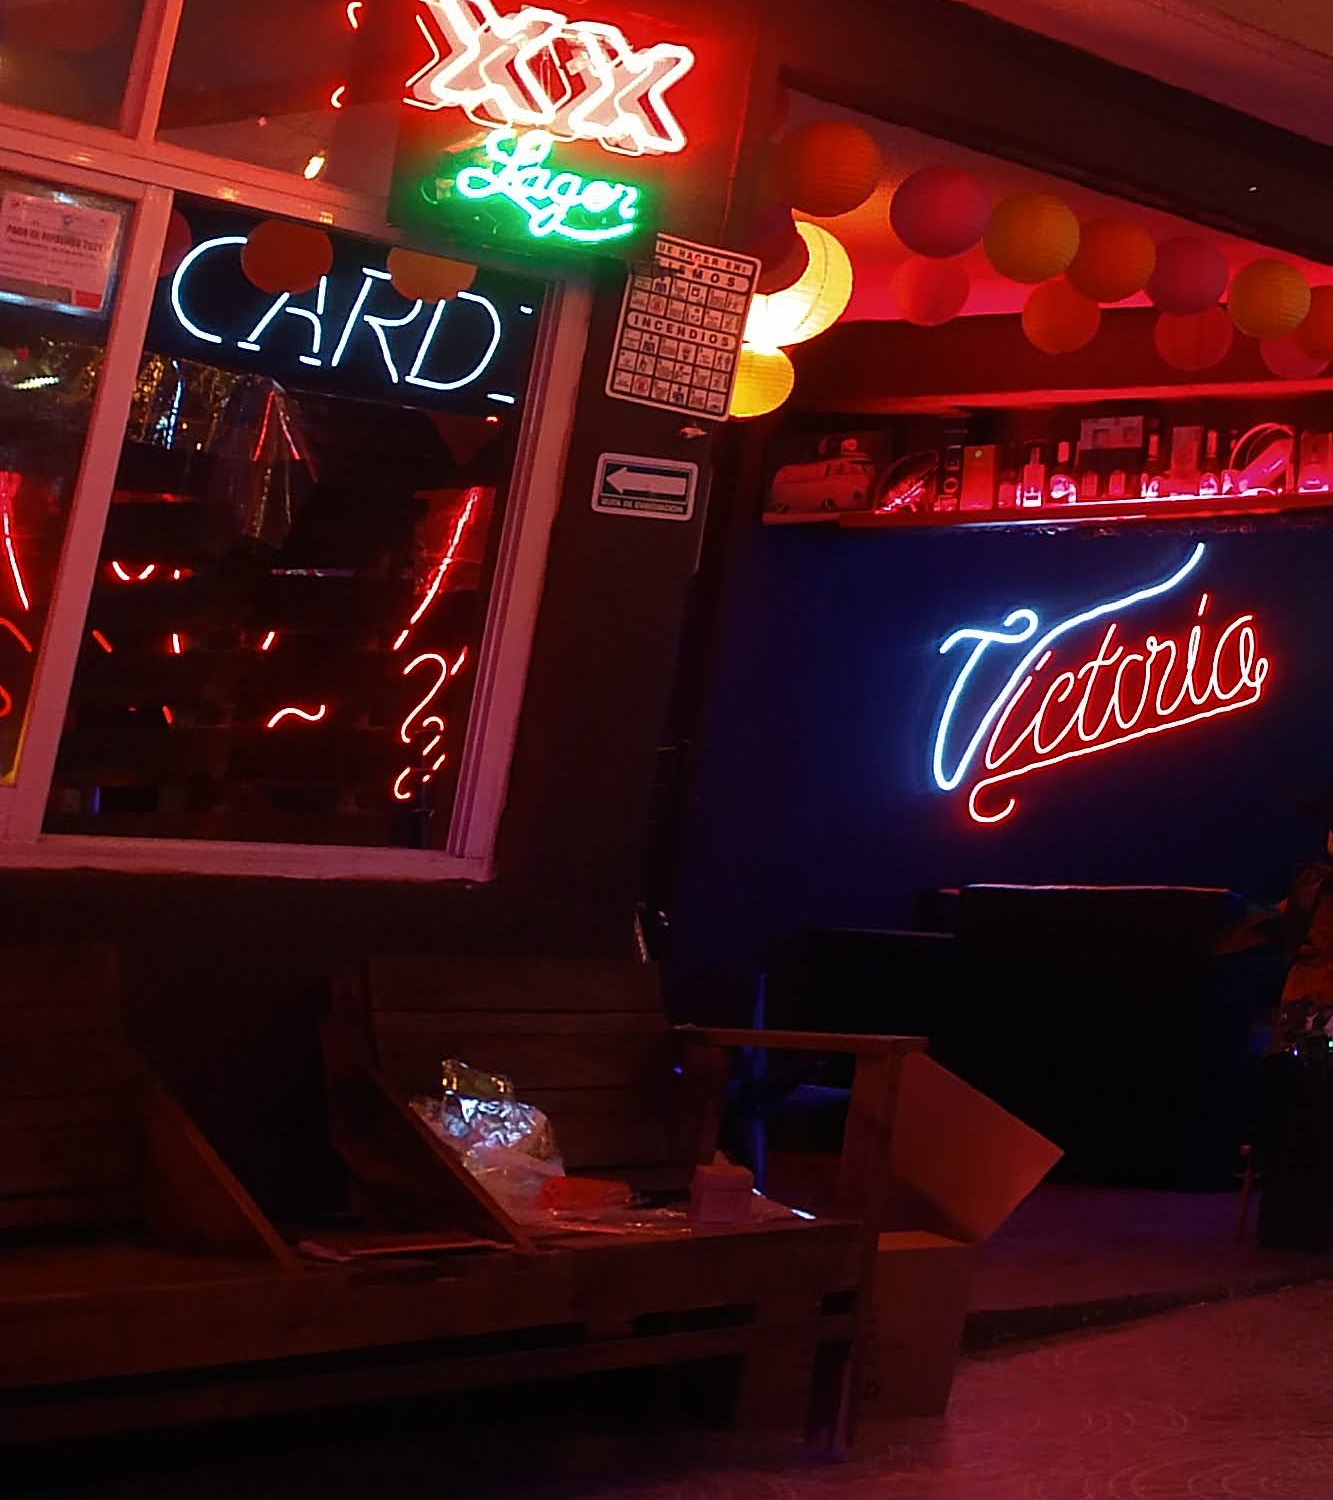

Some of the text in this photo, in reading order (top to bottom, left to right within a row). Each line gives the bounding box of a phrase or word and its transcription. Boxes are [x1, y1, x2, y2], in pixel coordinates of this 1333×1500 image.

[455, 129, 638, 242] Lager
[633, 313, 731, 347] INCENDIOS
[933, 542, 1269, 822] Victoria
